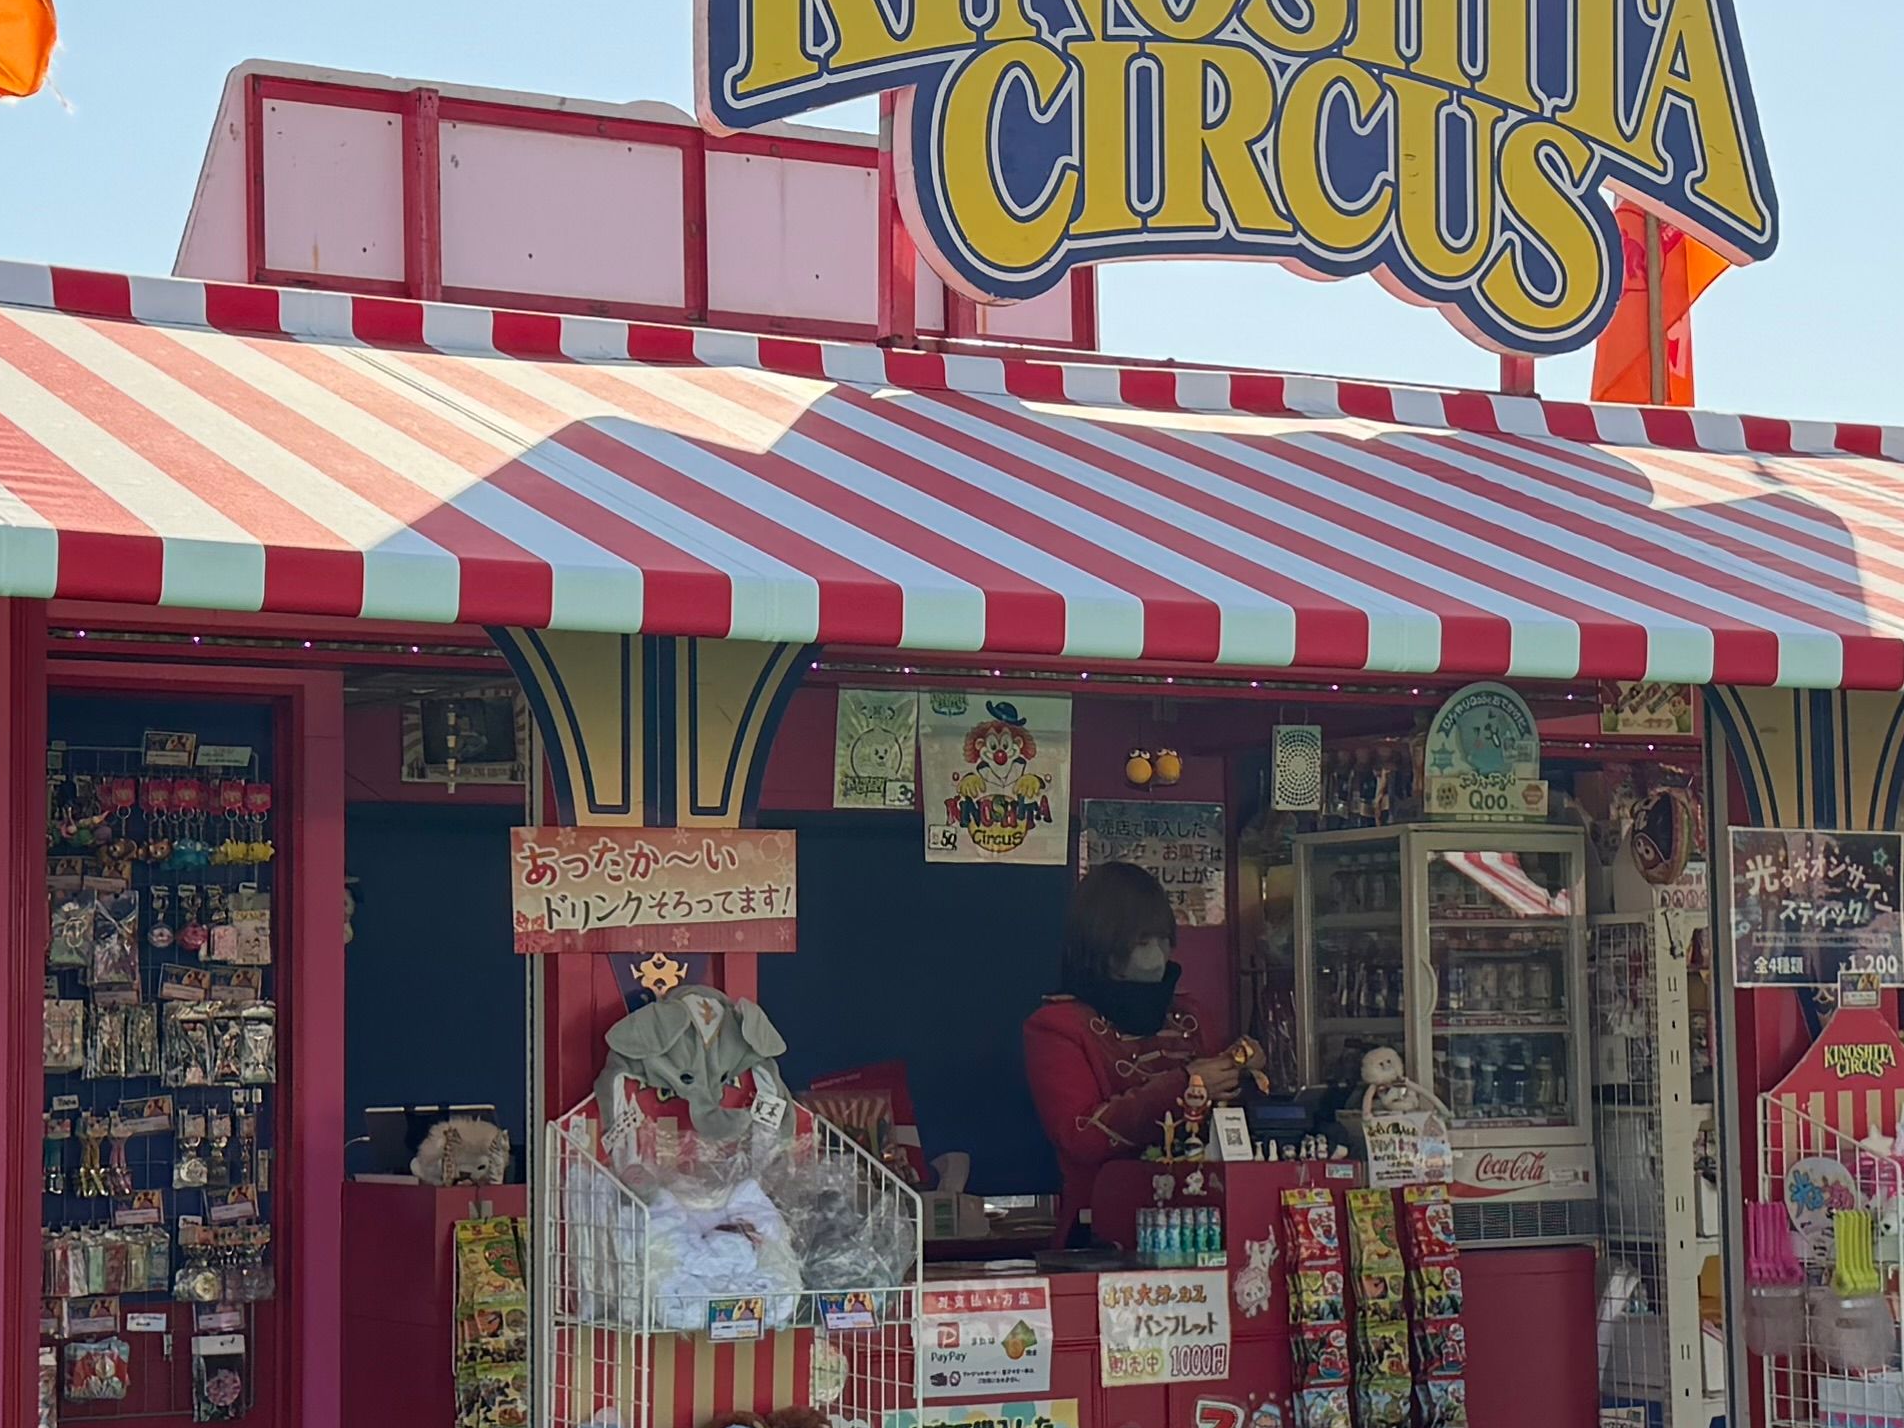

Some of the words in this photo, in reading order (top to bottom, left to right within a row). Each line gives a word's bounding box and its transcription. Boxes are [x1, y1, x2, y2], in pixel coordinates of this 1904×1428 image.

[940, 38, 1592, 330] CIRCUS
[944, 794, 1053, 829] KINOSHITA
[1469, 789, 1508, 811] Qoo
[972, 829, 1025, 847] Circus
[1779, 899, 1864, 926] スティック
[1754, 956, 1803, 974] 全4種類
[1825, 1044, 1896, 1068] KINOSHITA
[1836, 1056, 1884, 1078] CIRCUS
[1133, 1312, 1218, 1338] パンフレット
[930, 1351, 968, 1363] PayPay
[1170, 1344, 1227, 1378] 1000円
